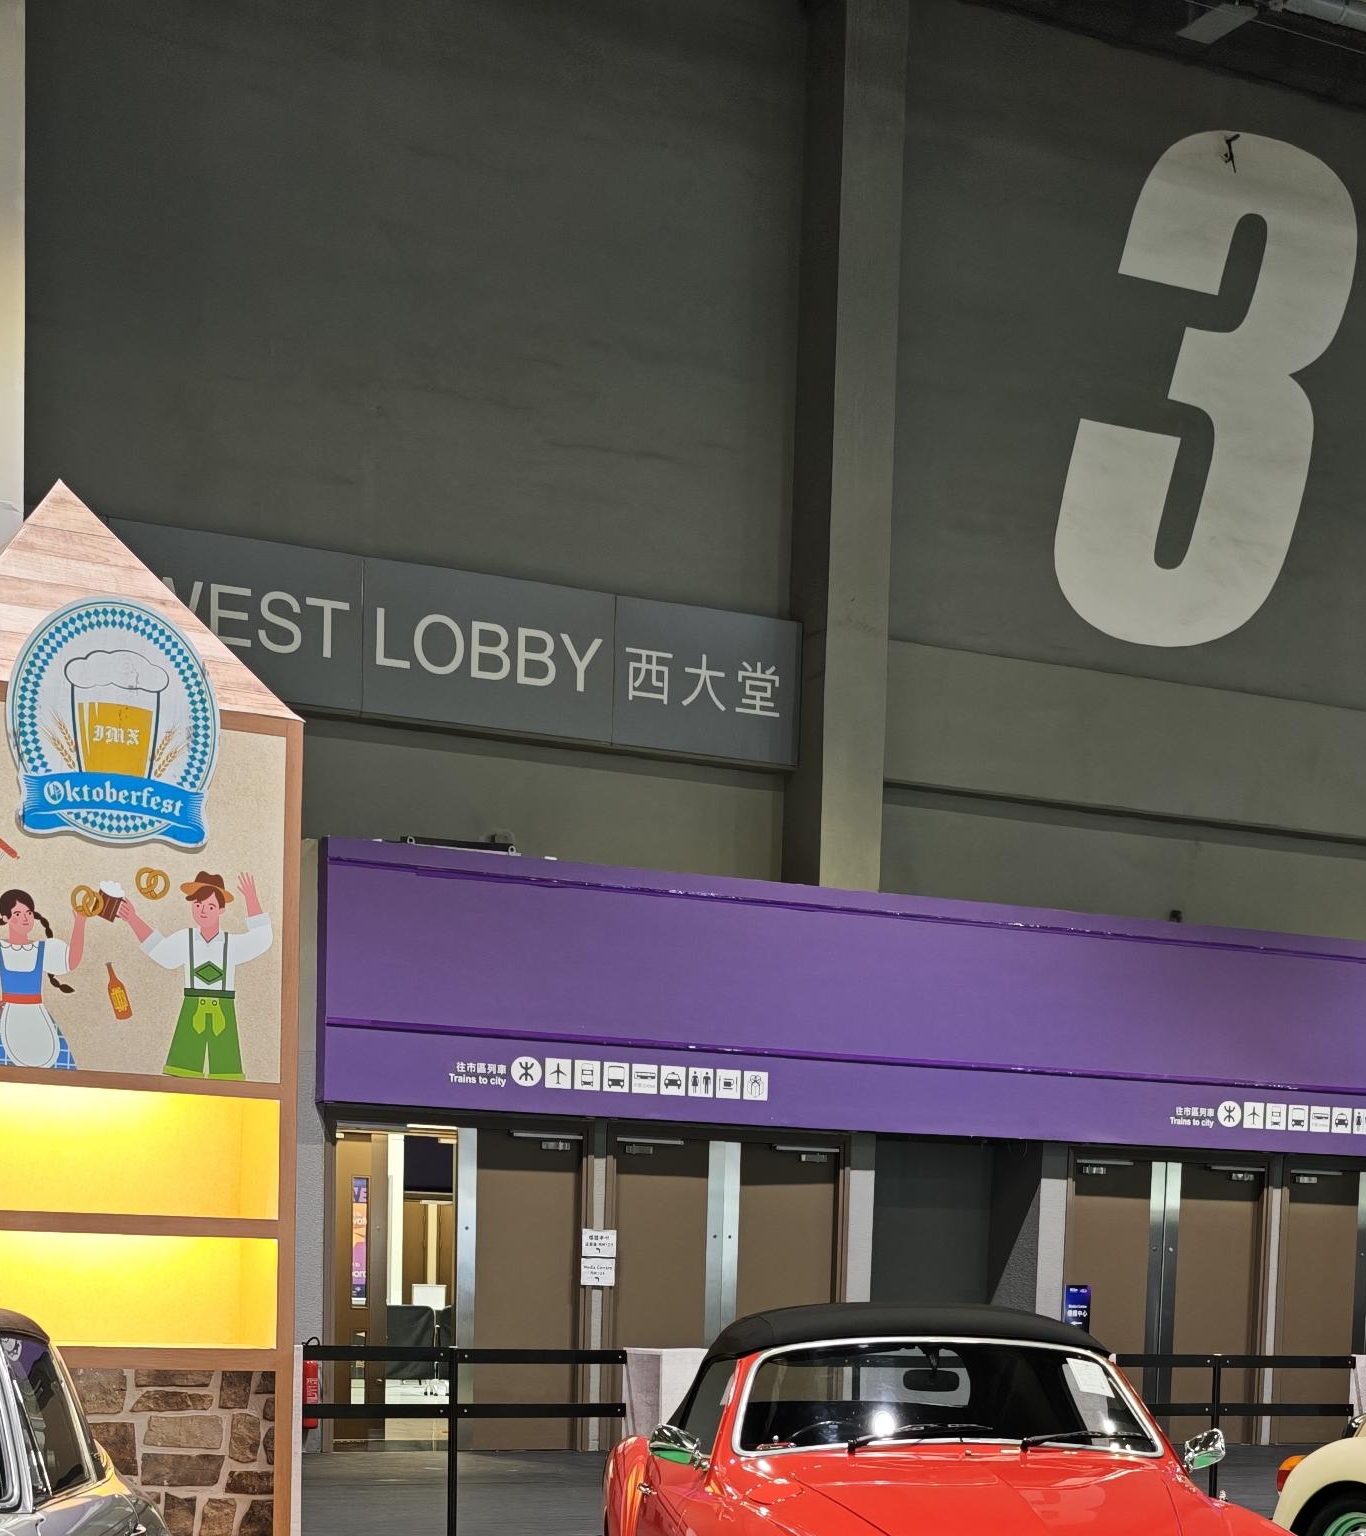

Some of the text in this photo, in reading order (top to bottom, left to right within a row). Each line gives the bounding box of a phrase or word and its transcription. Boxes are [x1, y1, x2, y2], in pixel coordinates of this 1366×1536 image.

[1054, 130, 1357, 647] 3
[375, 607, 603, 693] LOBBY
[625, 646, 781, 718] 西大堂
[43, 780, 183, 817] Oktoberfest
[448, 1073, 506, 1087] Trains to city
[456, 1061, 506, 1075] 往市區列車
[1169, 1116, 1191, 1126] Trains
[1201, 1119, 1214, 1128] city
